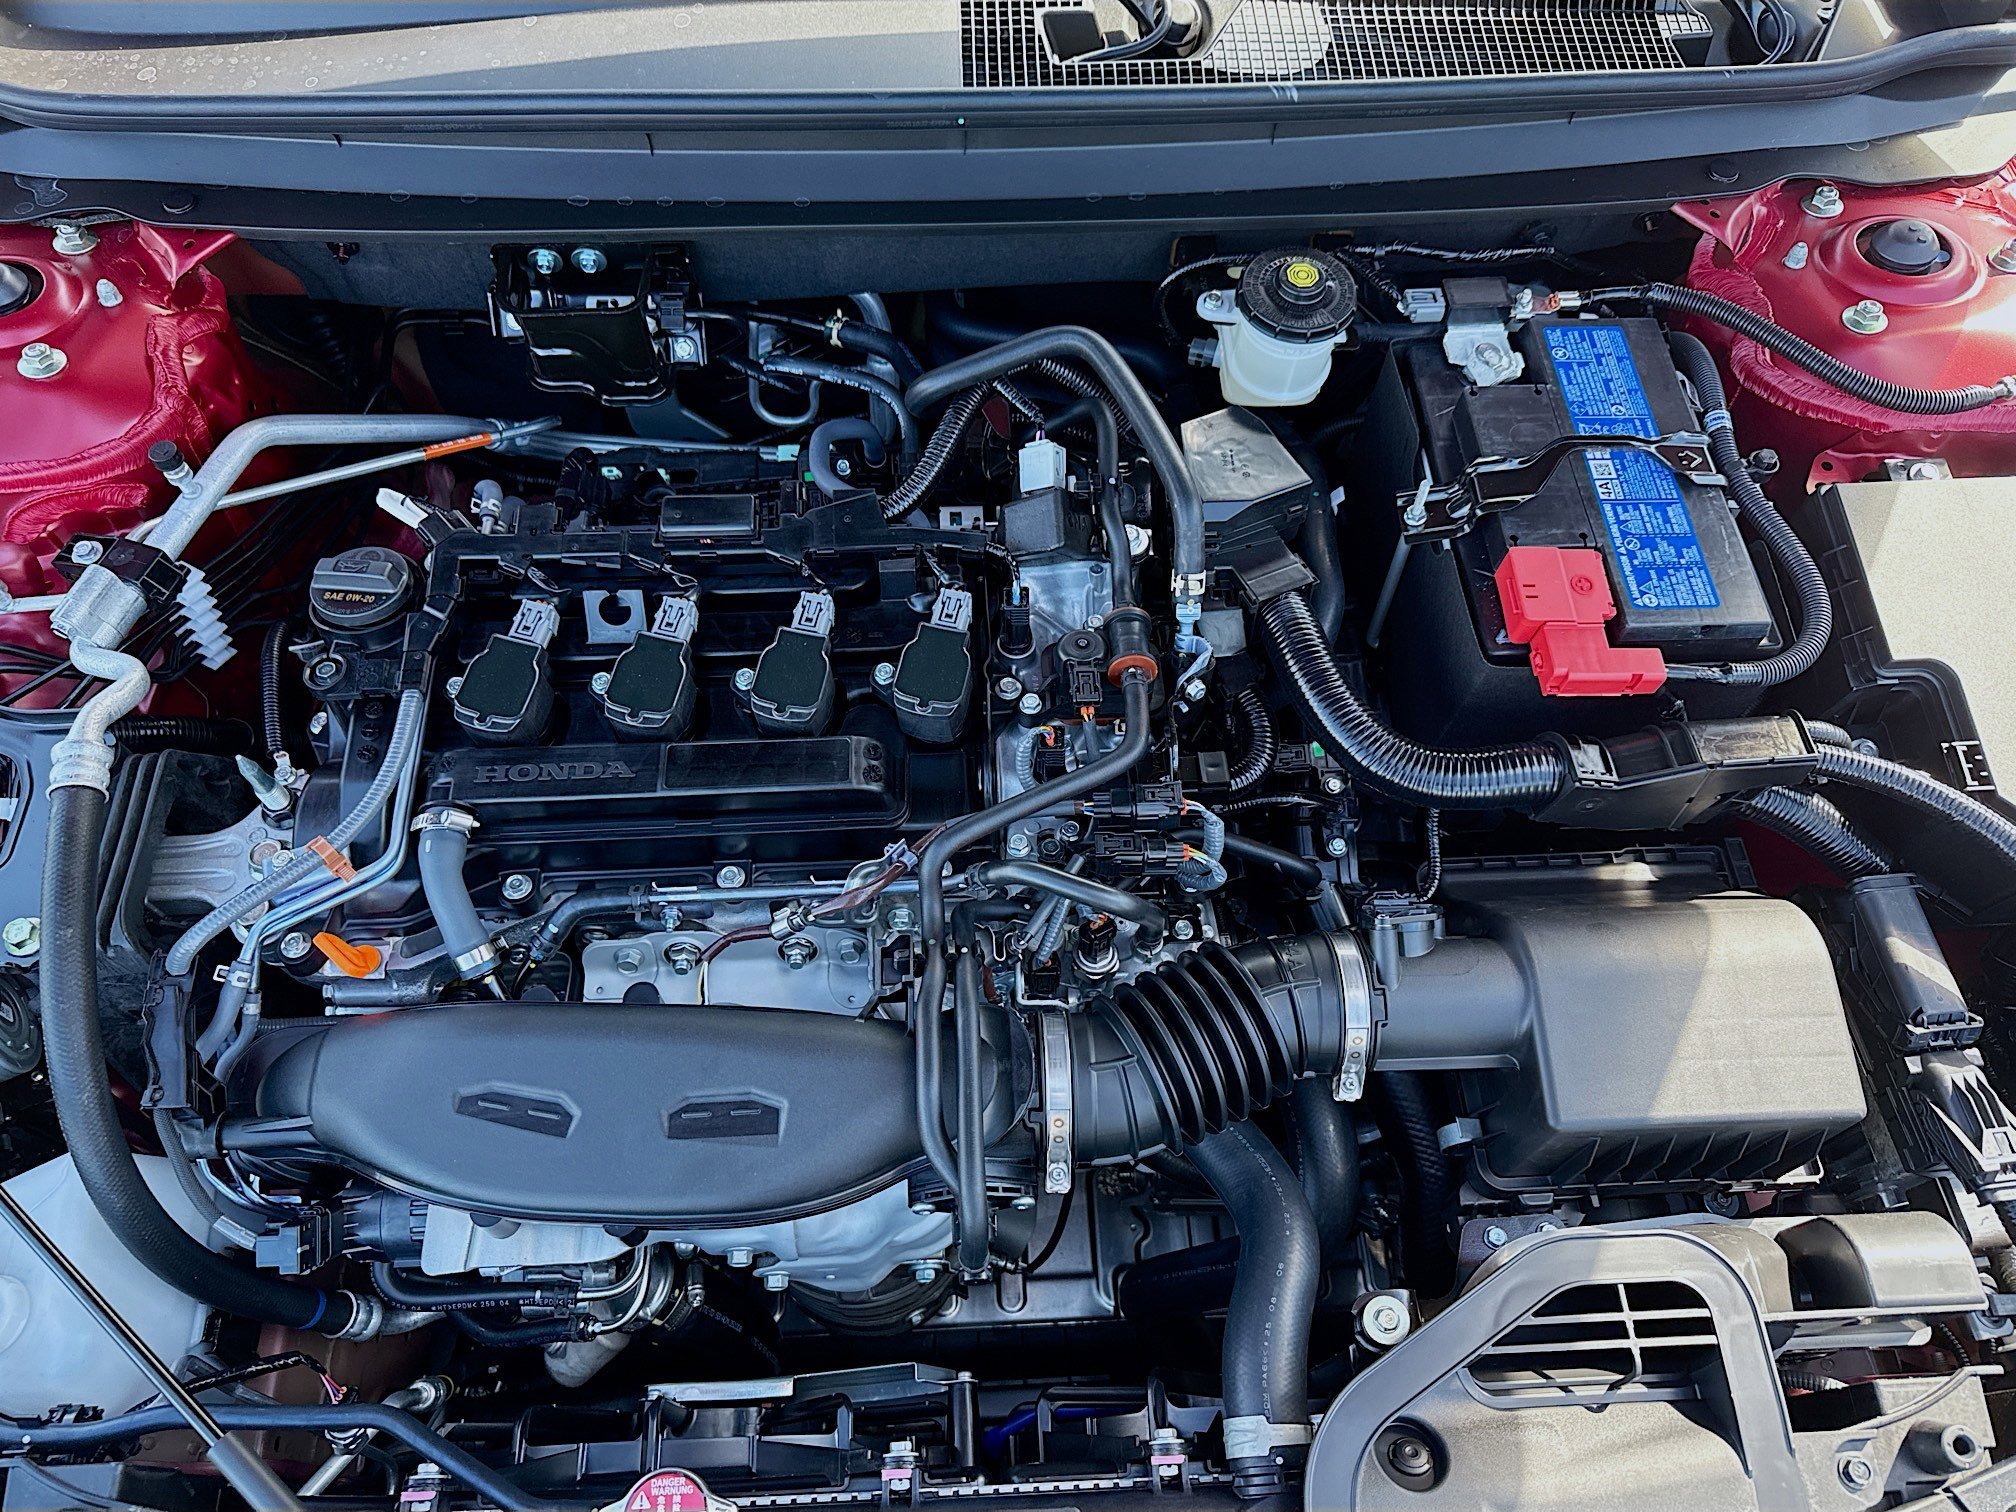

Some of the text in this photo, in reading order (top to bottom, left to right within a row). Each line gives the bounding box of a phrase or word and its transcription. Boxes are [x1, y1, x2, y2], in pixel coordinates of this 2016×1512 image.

[1598, 481, 1612, 497] 4A
[323, 591, 376, 603] SAE 0W-20
[473, 760, 637, 783] HONDA
[1283, 1212, 1292, 1225] C2
[1275, 1262, 1285, 1277] 06
[480, 1300, 495, 1309] 259
[499, 1299, 510, 1307] 04
[1268, 1296, 1278, 1312] 08
[1264, 1321, 1273, 1337] 25
[651, 1477, 686, 1487] DANGER
[651, 1485, 694, 1496] WARNUNG
